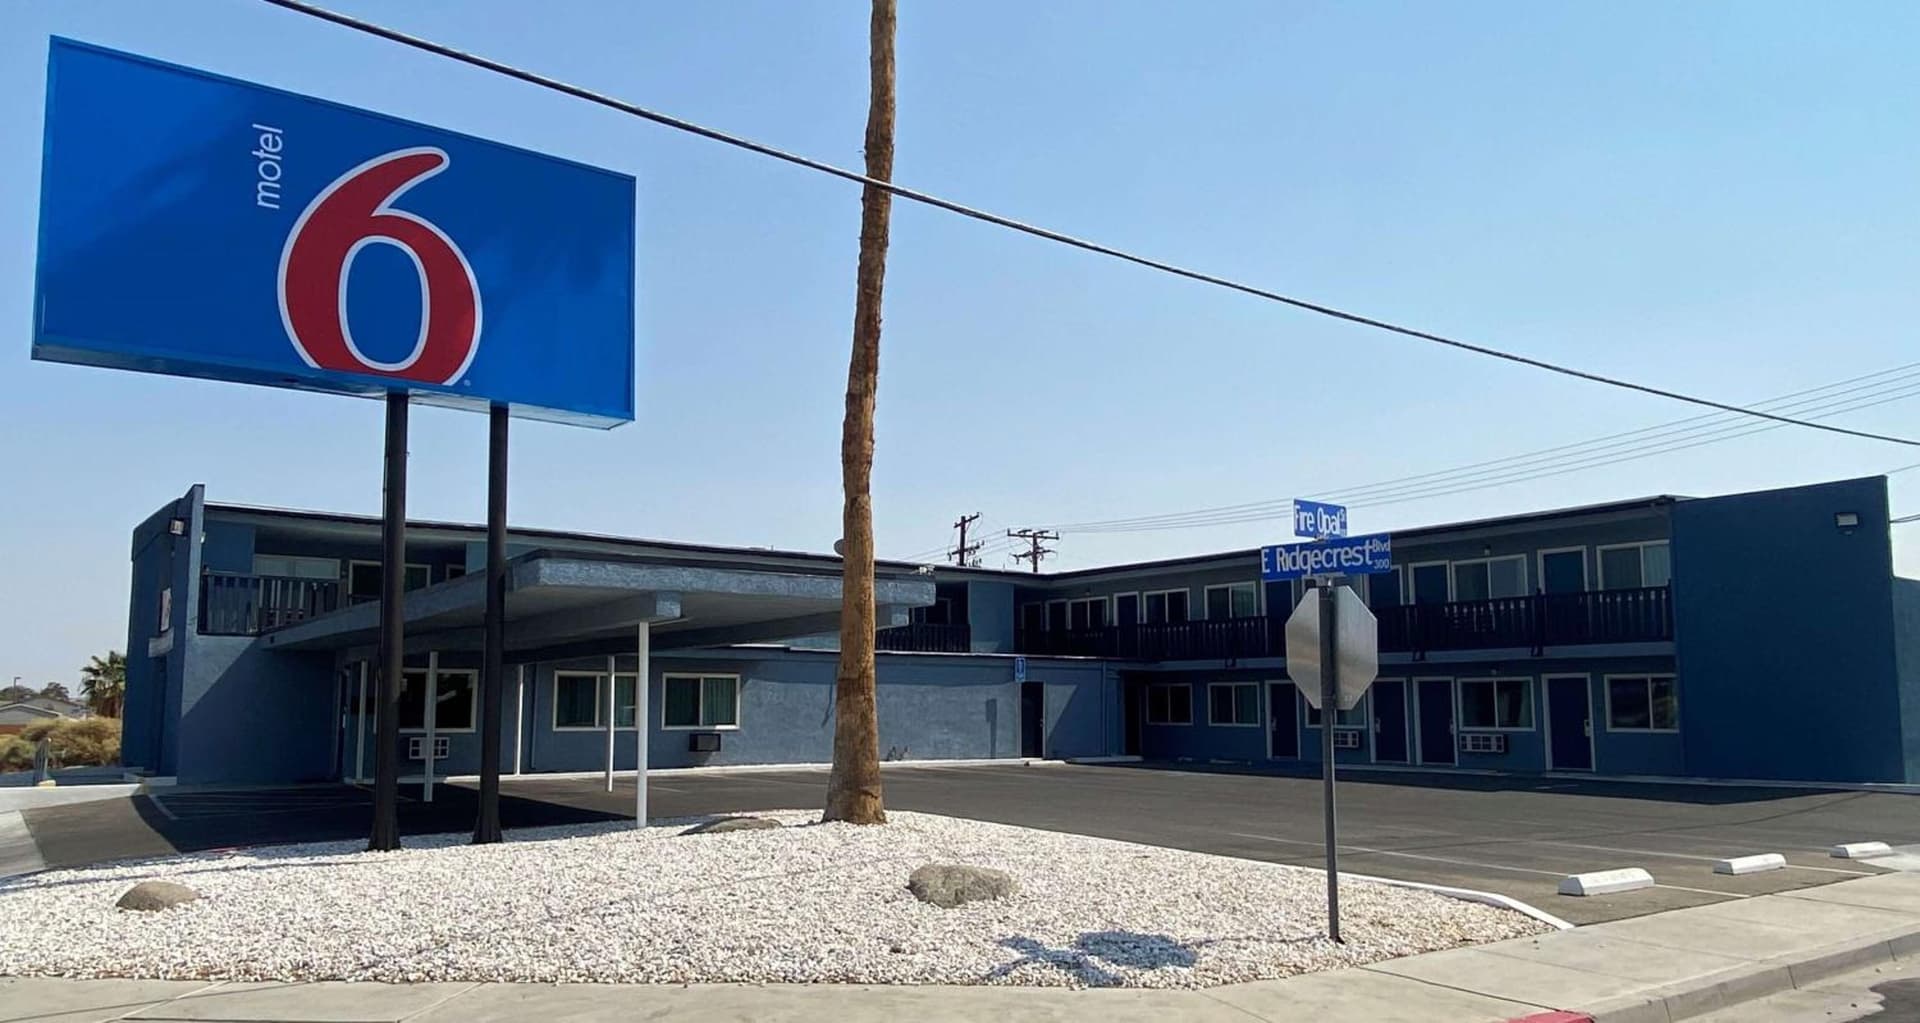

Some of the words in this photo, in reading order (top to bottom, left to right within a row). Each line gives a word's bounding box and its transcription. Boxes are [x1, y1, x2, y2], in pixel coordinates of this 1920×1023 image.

[252, 123, 283, 209] motel
[277, 146, 483, 386] 6
[1294, 505, 1315, 532] Fire
[1317, 507, 1340, 537] Opal
[1261, 548, 1271, 573] E
[1276, 539, 1373, 576] Ridgecrest
[1372, 538, 1391, 553] Blvd
[1373, 558, 1390, 570] 300
